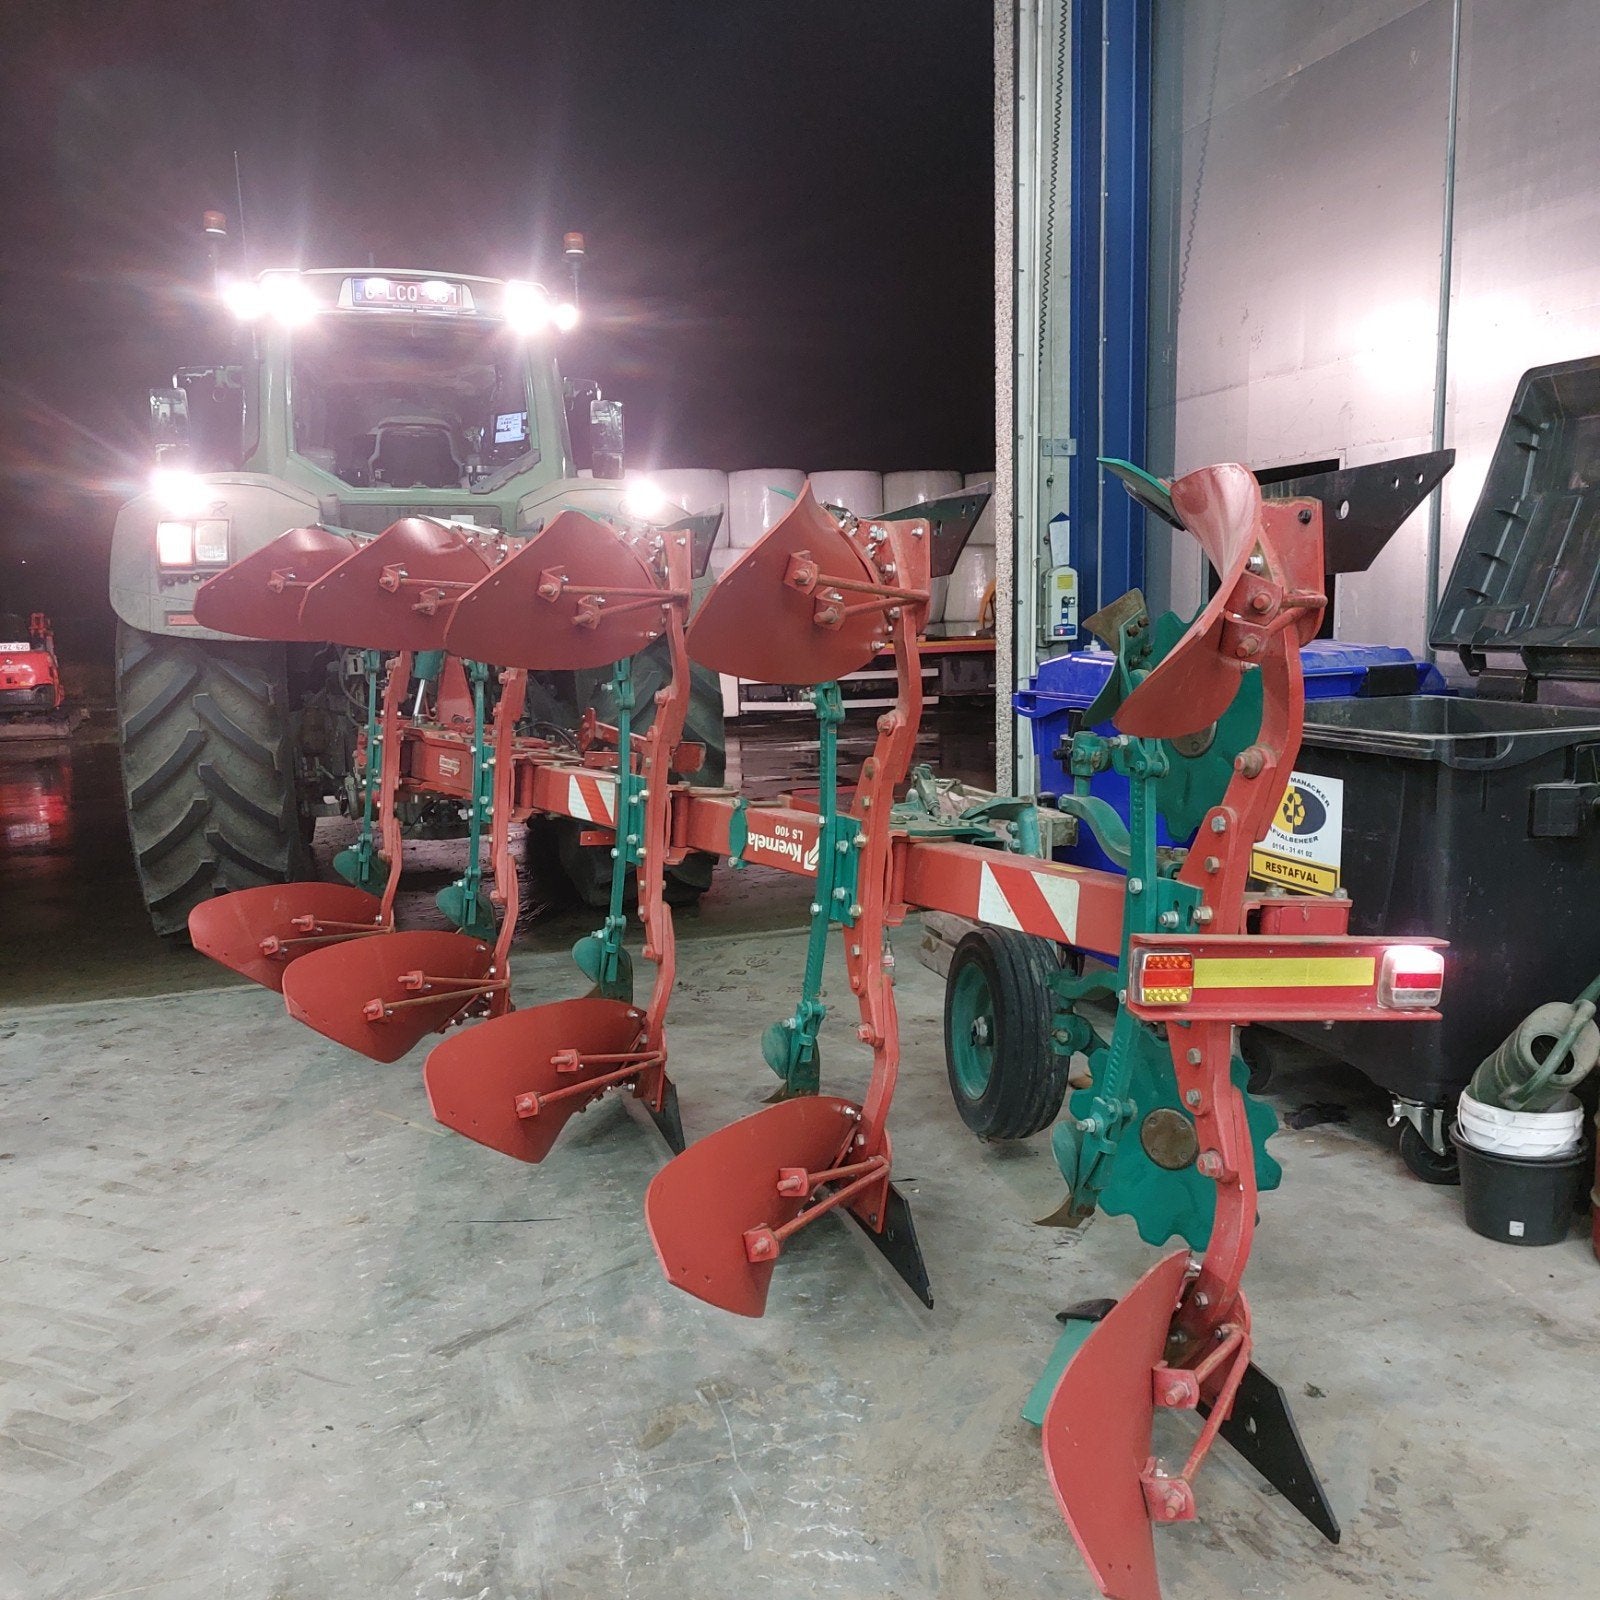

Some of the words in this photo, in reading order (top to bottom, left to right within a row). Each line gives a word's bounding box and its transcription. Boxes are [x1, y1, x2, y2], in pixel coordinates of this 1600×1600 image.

[1290, 777, 1330, 807] MANACKER
[775, 825, 790, 838] 100
[793, 829, 803, 840] LS
[1265, 861, 1319, 884] RESTAFVAL
